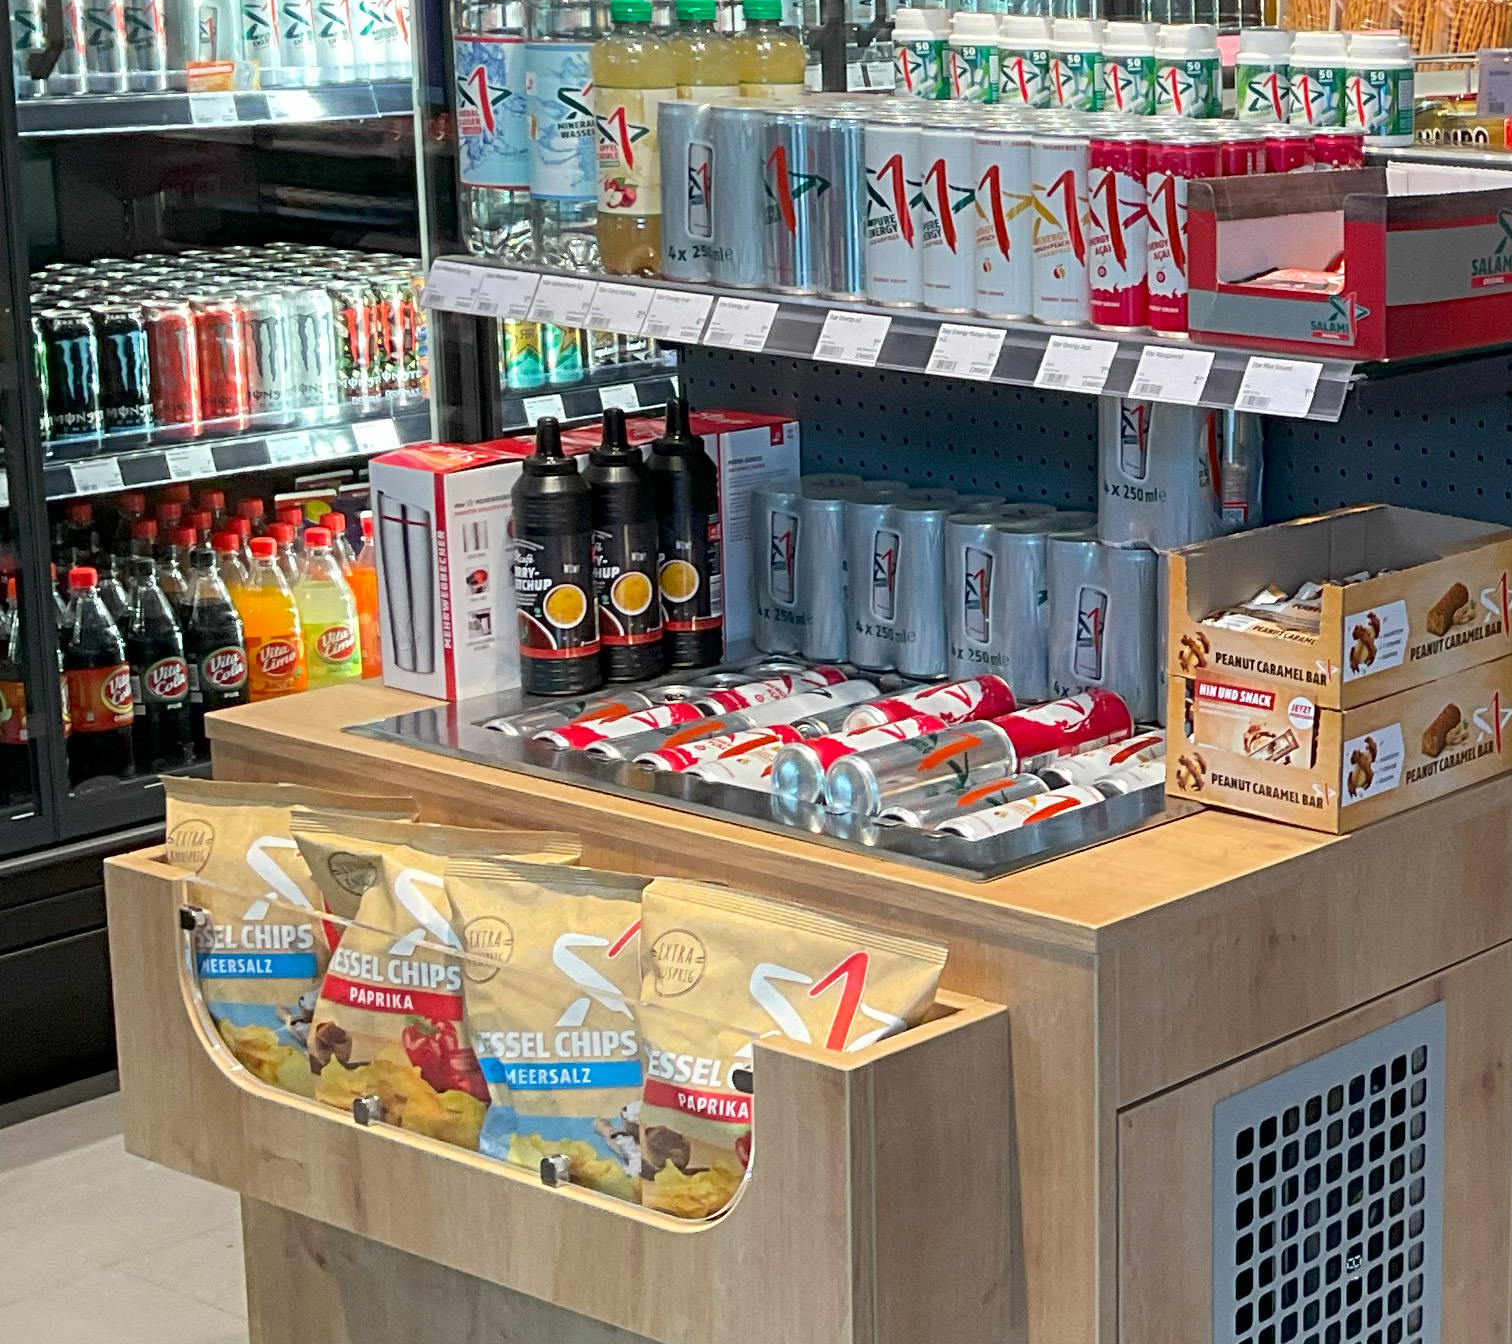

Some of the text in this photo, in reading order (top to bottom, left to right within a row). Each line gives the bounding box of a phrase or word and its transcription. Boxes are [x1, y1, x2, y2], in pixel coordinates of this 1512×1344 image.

[914, 41, 930, 51] 50
[961, 46, 976, 57] 50
[1032, 51, 1047, 61] 50
[1066, 54, 1081, 64] 50
[1126, 57, 1142, 68] 50
[1186, 61, 1201, 72] 50
[1318, 69, 1334, 80] 50
[1370, 71, 1386, 82] 50
[560, 130, 596, 139] WASSE
[868, 222, 899, 239] ENERGY
[872, 213, 897, 227] PURE
[1310, 320, 1350, 336] SALAMI
[435, 529, 453, 652] MEHRWEGBECHER
[320, 629, 349, 648] Vita
[323, 634, 355, 658] Limo
[1284, 629, 1318, 646] CARAME
[1410, 620, 1503, 663] PEANUT CARAMEL BAR
[209, 653, 240, 673] Vita
[260, 642, 290, 663] Vita
[262, 651, 297, 673] Limo
[152, 663, 181, 685] Vita
[212, 661, 244, 684] Cola
[1214, 651, 1328, 687] PEANUT CARAMEL BAR
[154, 674, 187, 697] Cola
[1217, 684, 1239, 702] UND
[1240, 689, 1273, 709] SNACK
[1290, 703, 1312, 716] JETZT
[1405, 742, 1495, 786] PEANUT CARAMEL BAR
[1210, 772, 1324, 810] PEANUT CARAMEL BAR
[176, 830, 205, 847] EXTRA
[241, 923, 314, 951] CHIPS
[467, 928, 502, 950] EXTRA
[655, 942, 696, 966] EXTRA
[333, 949, 463, 991] ESSEL CHIPS
[349, 987, 414, 1011] PAPRIKA
[479, 1029, 638, 1059] ESSEL CHIPS
[505, 1067, 592, 1086] MEERSALZ
[647, 1047, 723, 1087] ESSEL
[677, 1092, 749, 1120] PAPRIKA
